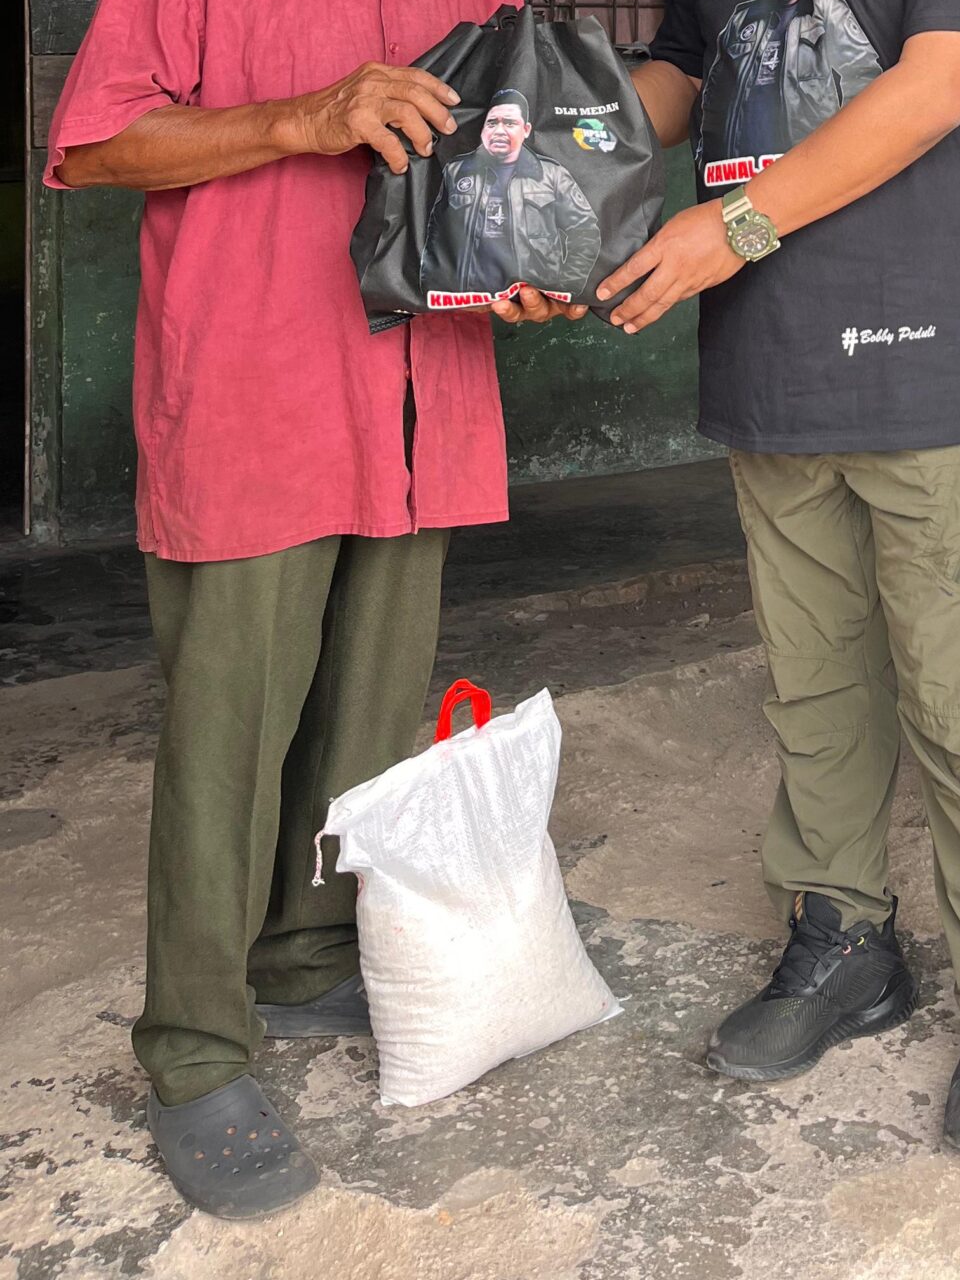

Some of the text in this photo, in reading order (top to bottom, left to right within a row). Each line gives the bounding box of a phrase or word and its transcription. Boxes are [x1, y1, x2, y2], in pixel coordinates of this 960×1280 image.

[554, 102, 620, 116] DLH MEDAN
[706, 160, 757, 184] KAWAL
[430, 293, 491, 307] KAWAL
[898, 325, 937, 342] Peduli
